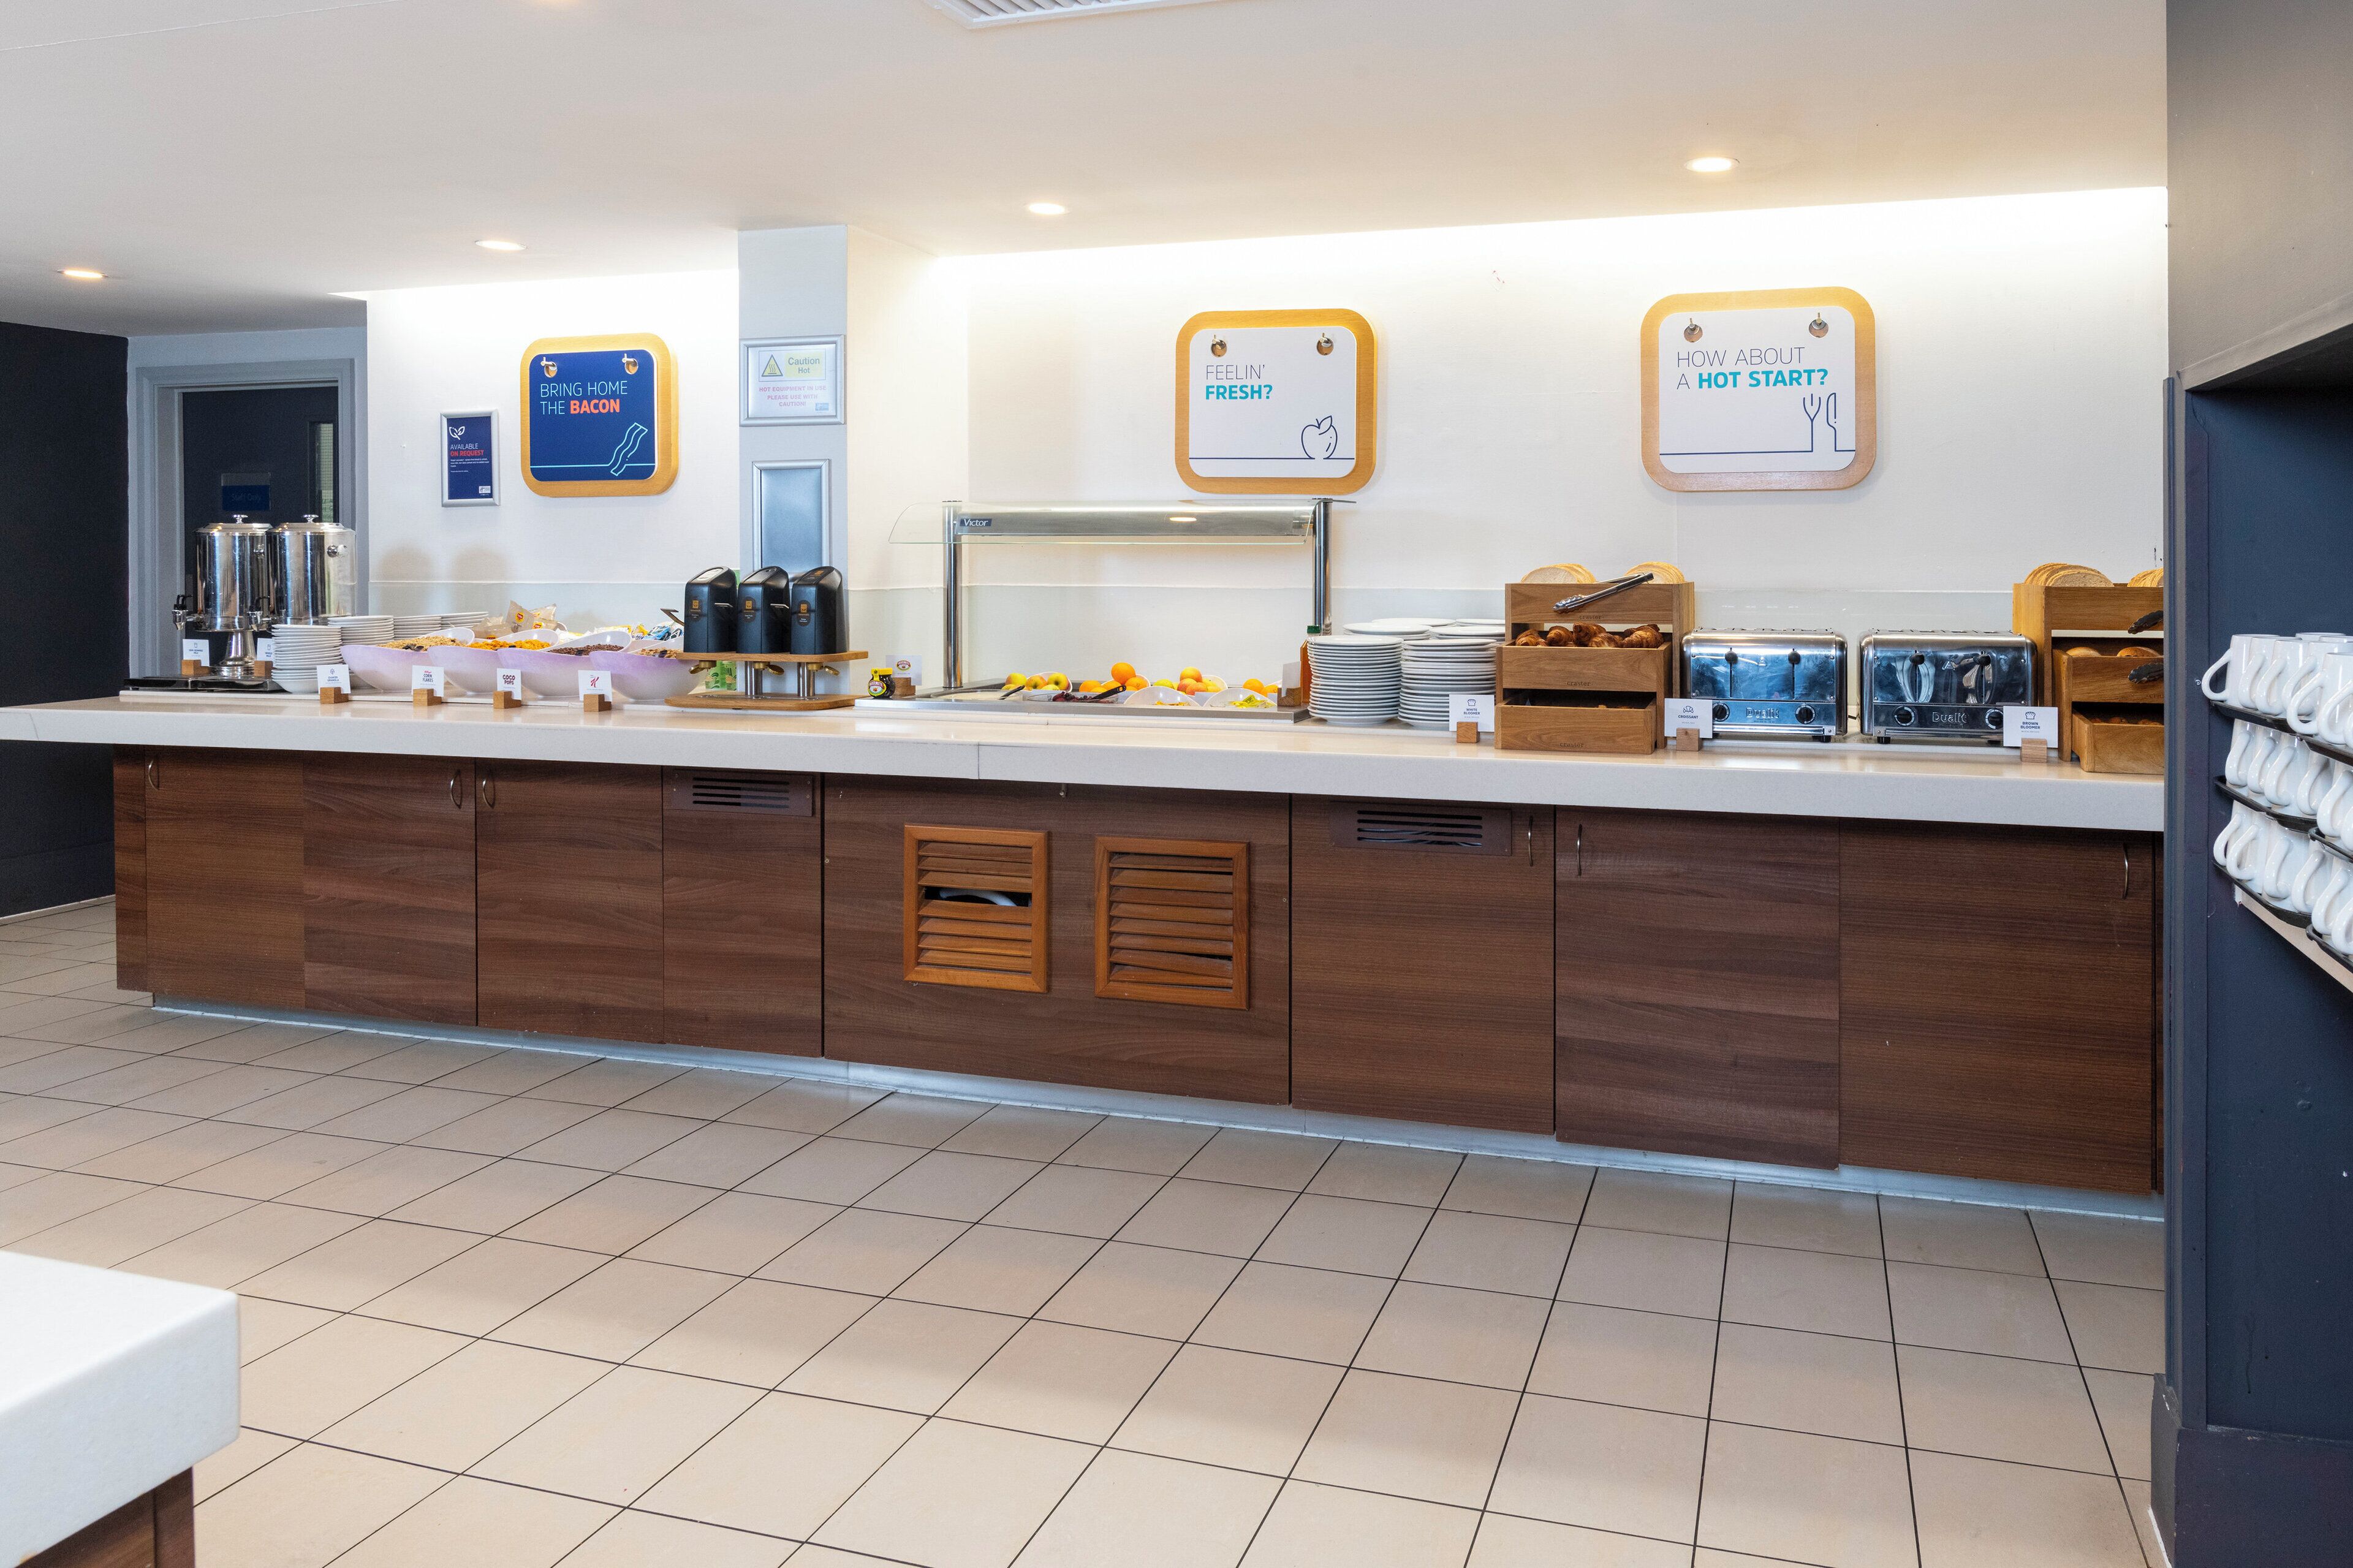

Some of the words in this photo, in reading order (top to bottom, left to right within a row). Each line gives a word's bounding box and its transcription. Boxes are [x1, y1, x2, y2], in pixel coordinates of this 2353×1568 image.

[788, 357, 820, 366] Caution
[1677, 349, 1727, 368] HOW
[1735, 347, 1805, 366] ABOUT
[1206, 365, 1265, 380] FEELIN'
[1677, 373, 1691, 390] A
[1698, 371, 1741, 389] HOT
[1748, 368, 1828, 388] START?
[540, 382, 582, 397] BRING
[588, 381, 627, 395] HOME
[1205, 384, 1273, 400] FRESH?
[540, 401, 565, 415] THE
[570, 399, 620, 414] BACON
[1746, 707, 1779, 718] Dualit
[1932, 711, 1968, 723] Dualit
